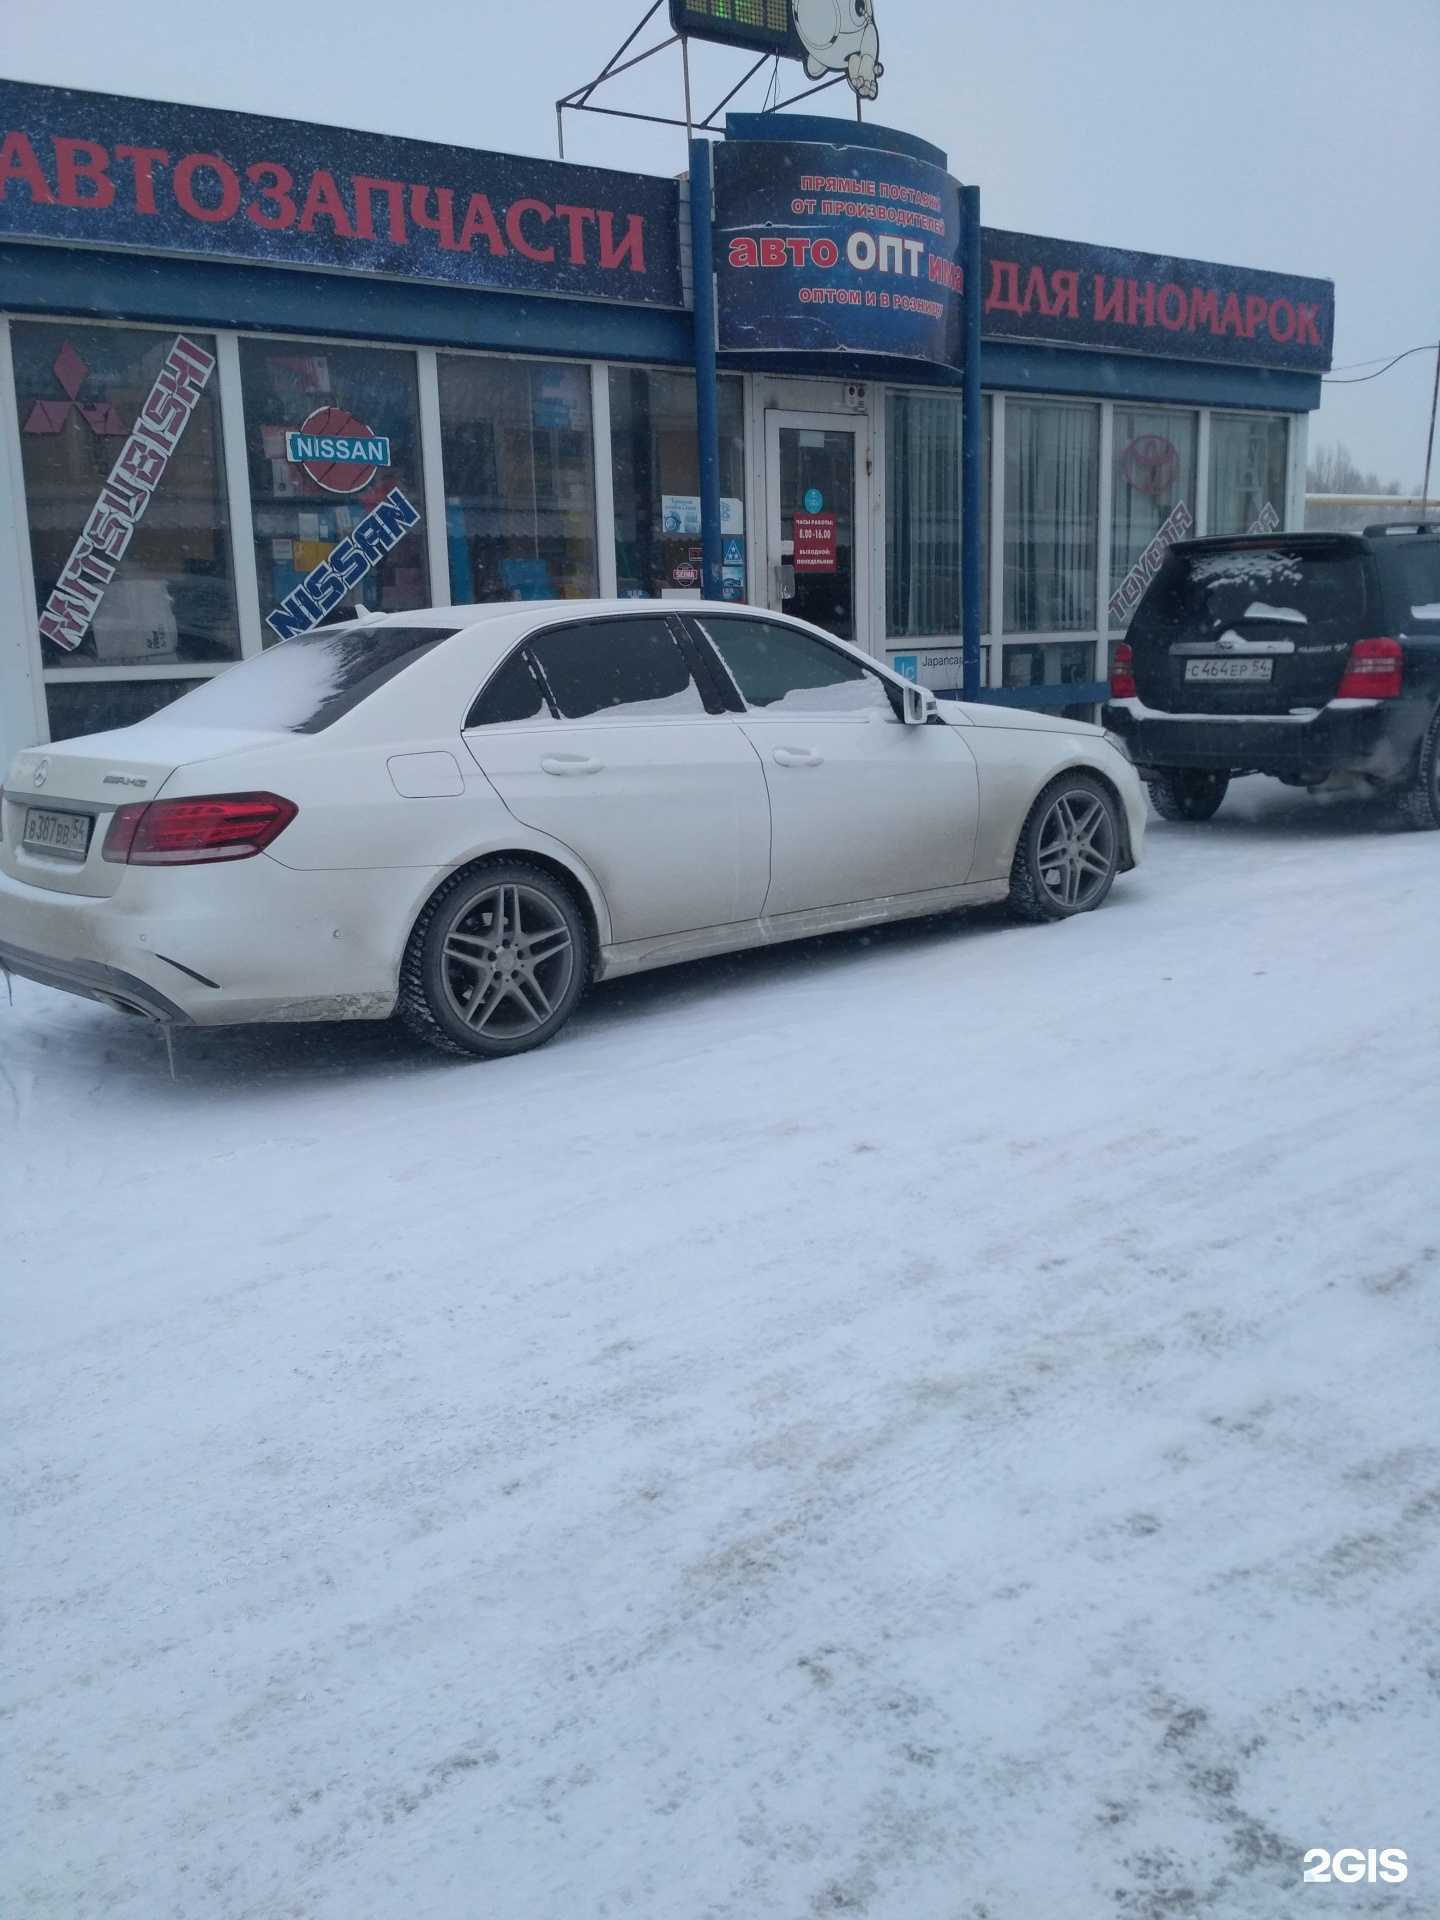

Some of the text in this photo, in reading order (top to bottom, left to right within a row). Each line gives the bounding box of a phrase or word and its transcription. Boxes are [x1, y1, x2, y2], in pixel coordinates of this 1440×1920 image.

[0, 132, 646, 273] АВТОЗАПЧАСТИ
[791, 198, 816, 214] ОТ
[800, 175, 876, 197] ПРЯМЫЕ
[728, 237, 839, 268] авто
[846, 231, 924, 278] ОПТ
[799, 288, 862, 305] ОПТОМ
[865, 291, 877, 306] И
[880, 292, 890, 308] В
[984, 260, 1322, 347] ДЛЯ ИНОМАРОК
[297, 437, 383, 461] NISSAN
[39, 334, 216, 652] MITSUBISHI
[265, 486, 421, 641] NISSAN
[1107, 500, 1193, 622] TOYOTA
